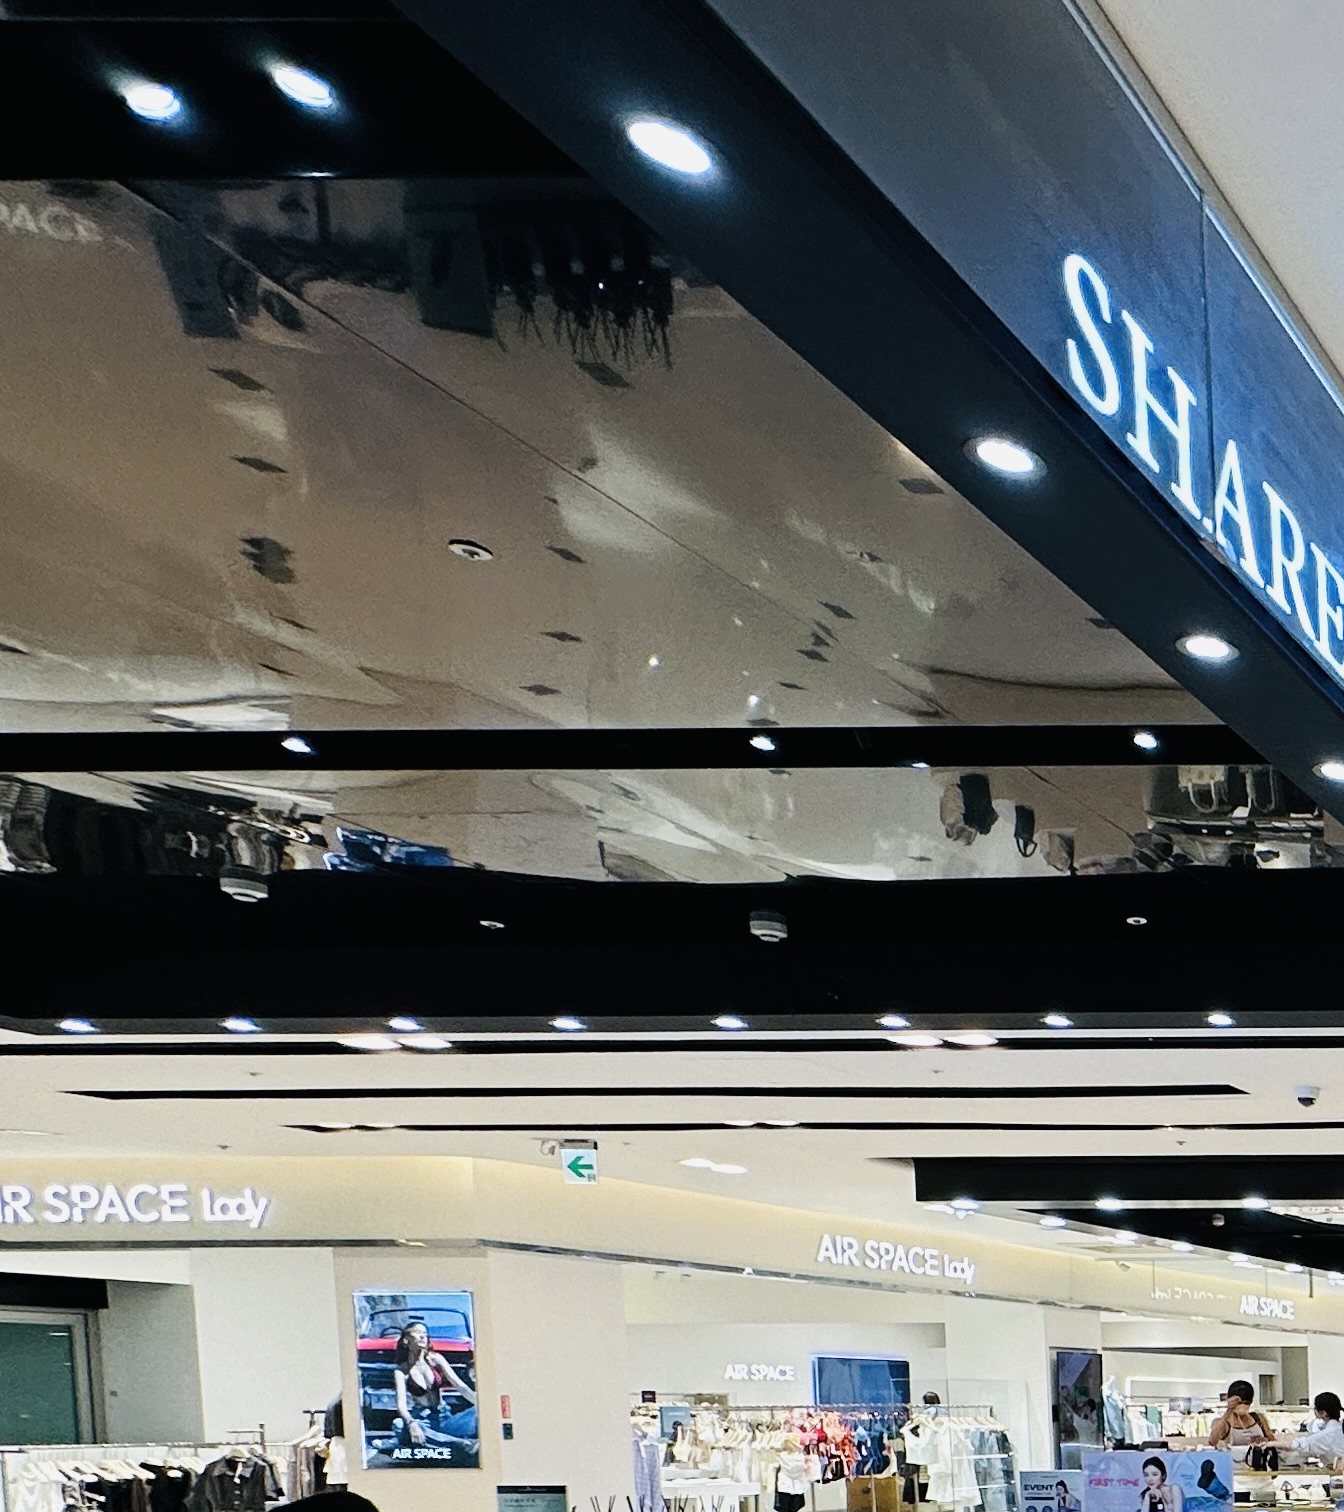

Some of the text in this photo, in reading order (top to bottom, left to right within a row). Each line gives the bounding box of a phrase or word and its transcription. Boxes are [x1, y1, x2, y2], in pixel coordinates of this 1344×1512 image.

[43, 1183, 190, 1223] SPACE
[201, 1187, 269, 1229] Lady
[817, 1234, 976, 1285] AIR SPACE Lady
[1240, 1294, 1296, 1321] AIR SPACE
[724, 1363, 795, 1381] AIR SPACE
[392, 1447, 452, 1460] AIR SPACE
[1024, 1483, 1055, 1492] EVENT
